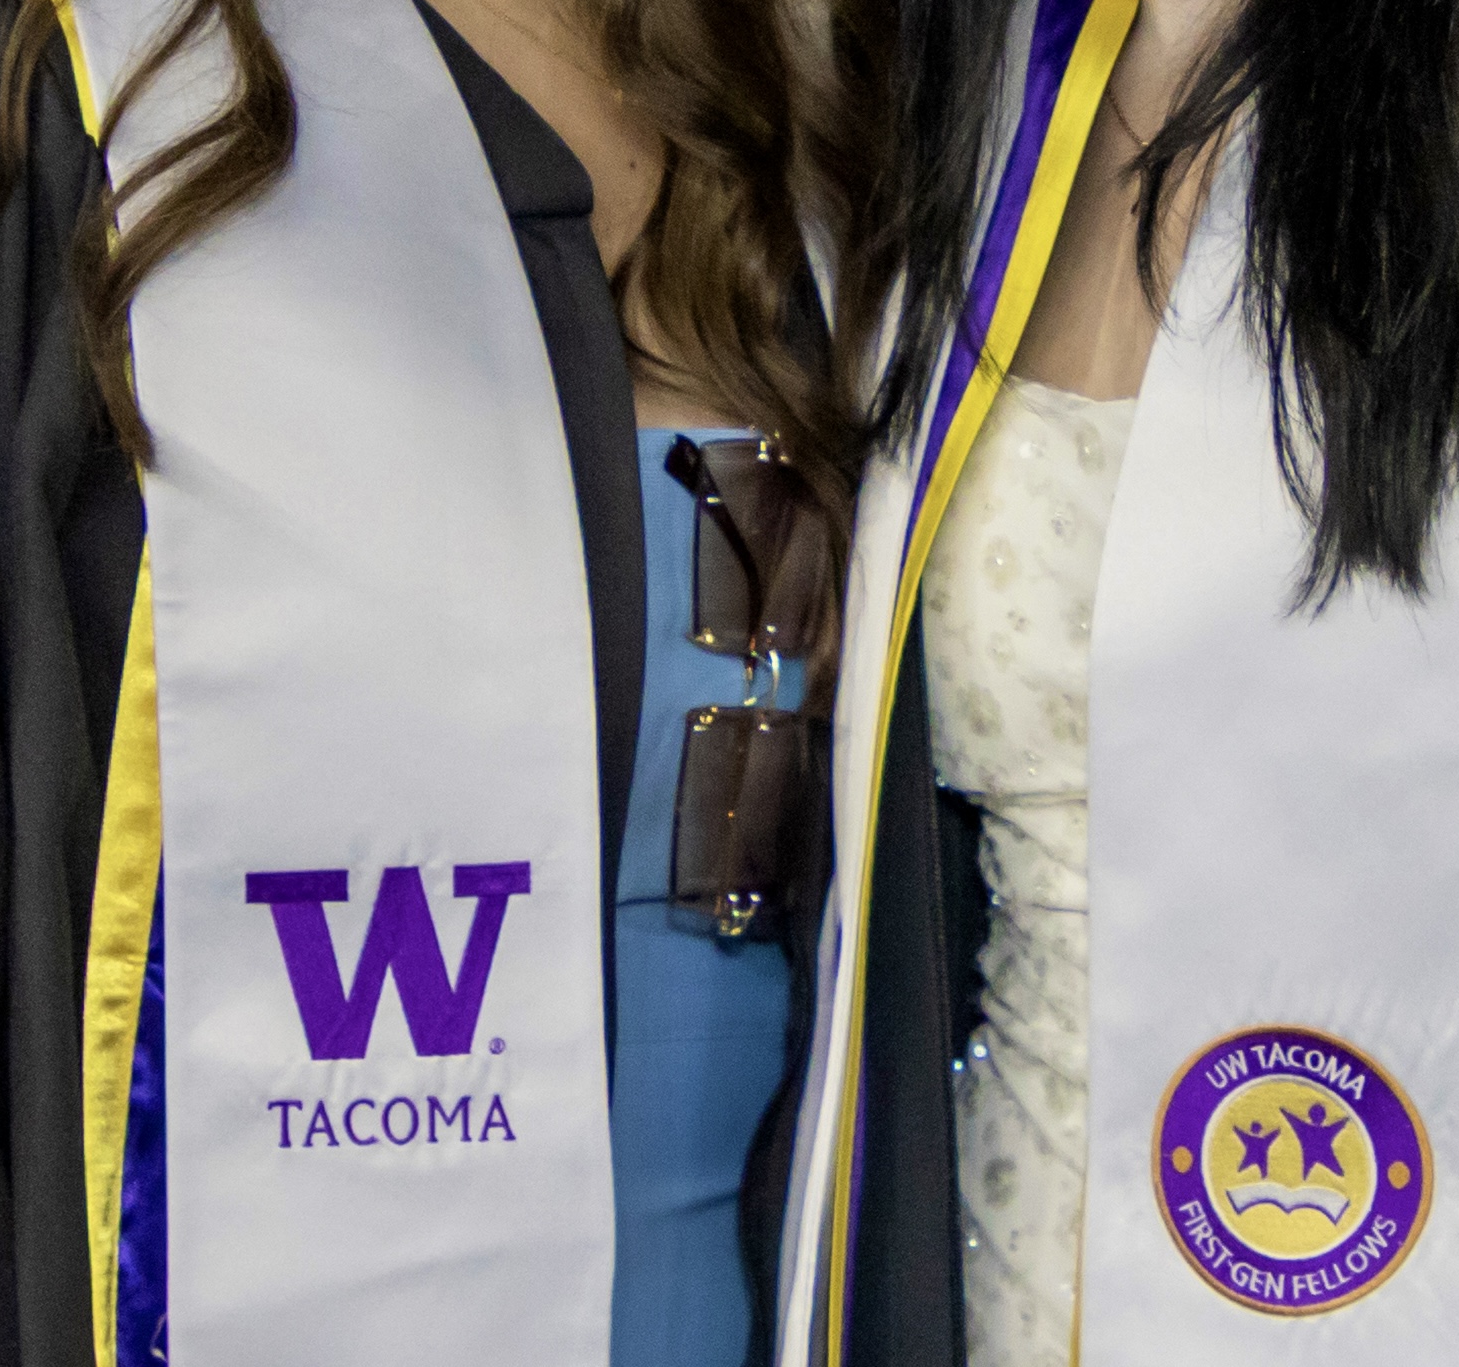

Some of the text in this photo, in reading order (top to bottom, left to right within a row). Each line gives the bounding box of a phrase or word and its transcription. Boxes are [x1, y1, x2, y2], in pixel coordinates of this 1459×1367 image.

[244, 860, 532, 1061] W
[1205, 1042, 1366, 1100] UW TACOMA
[267, 1094, 517, 1149] TACOMA
[1178, 1199, 1398, 1301] FIRST-GEN FELLOWS
